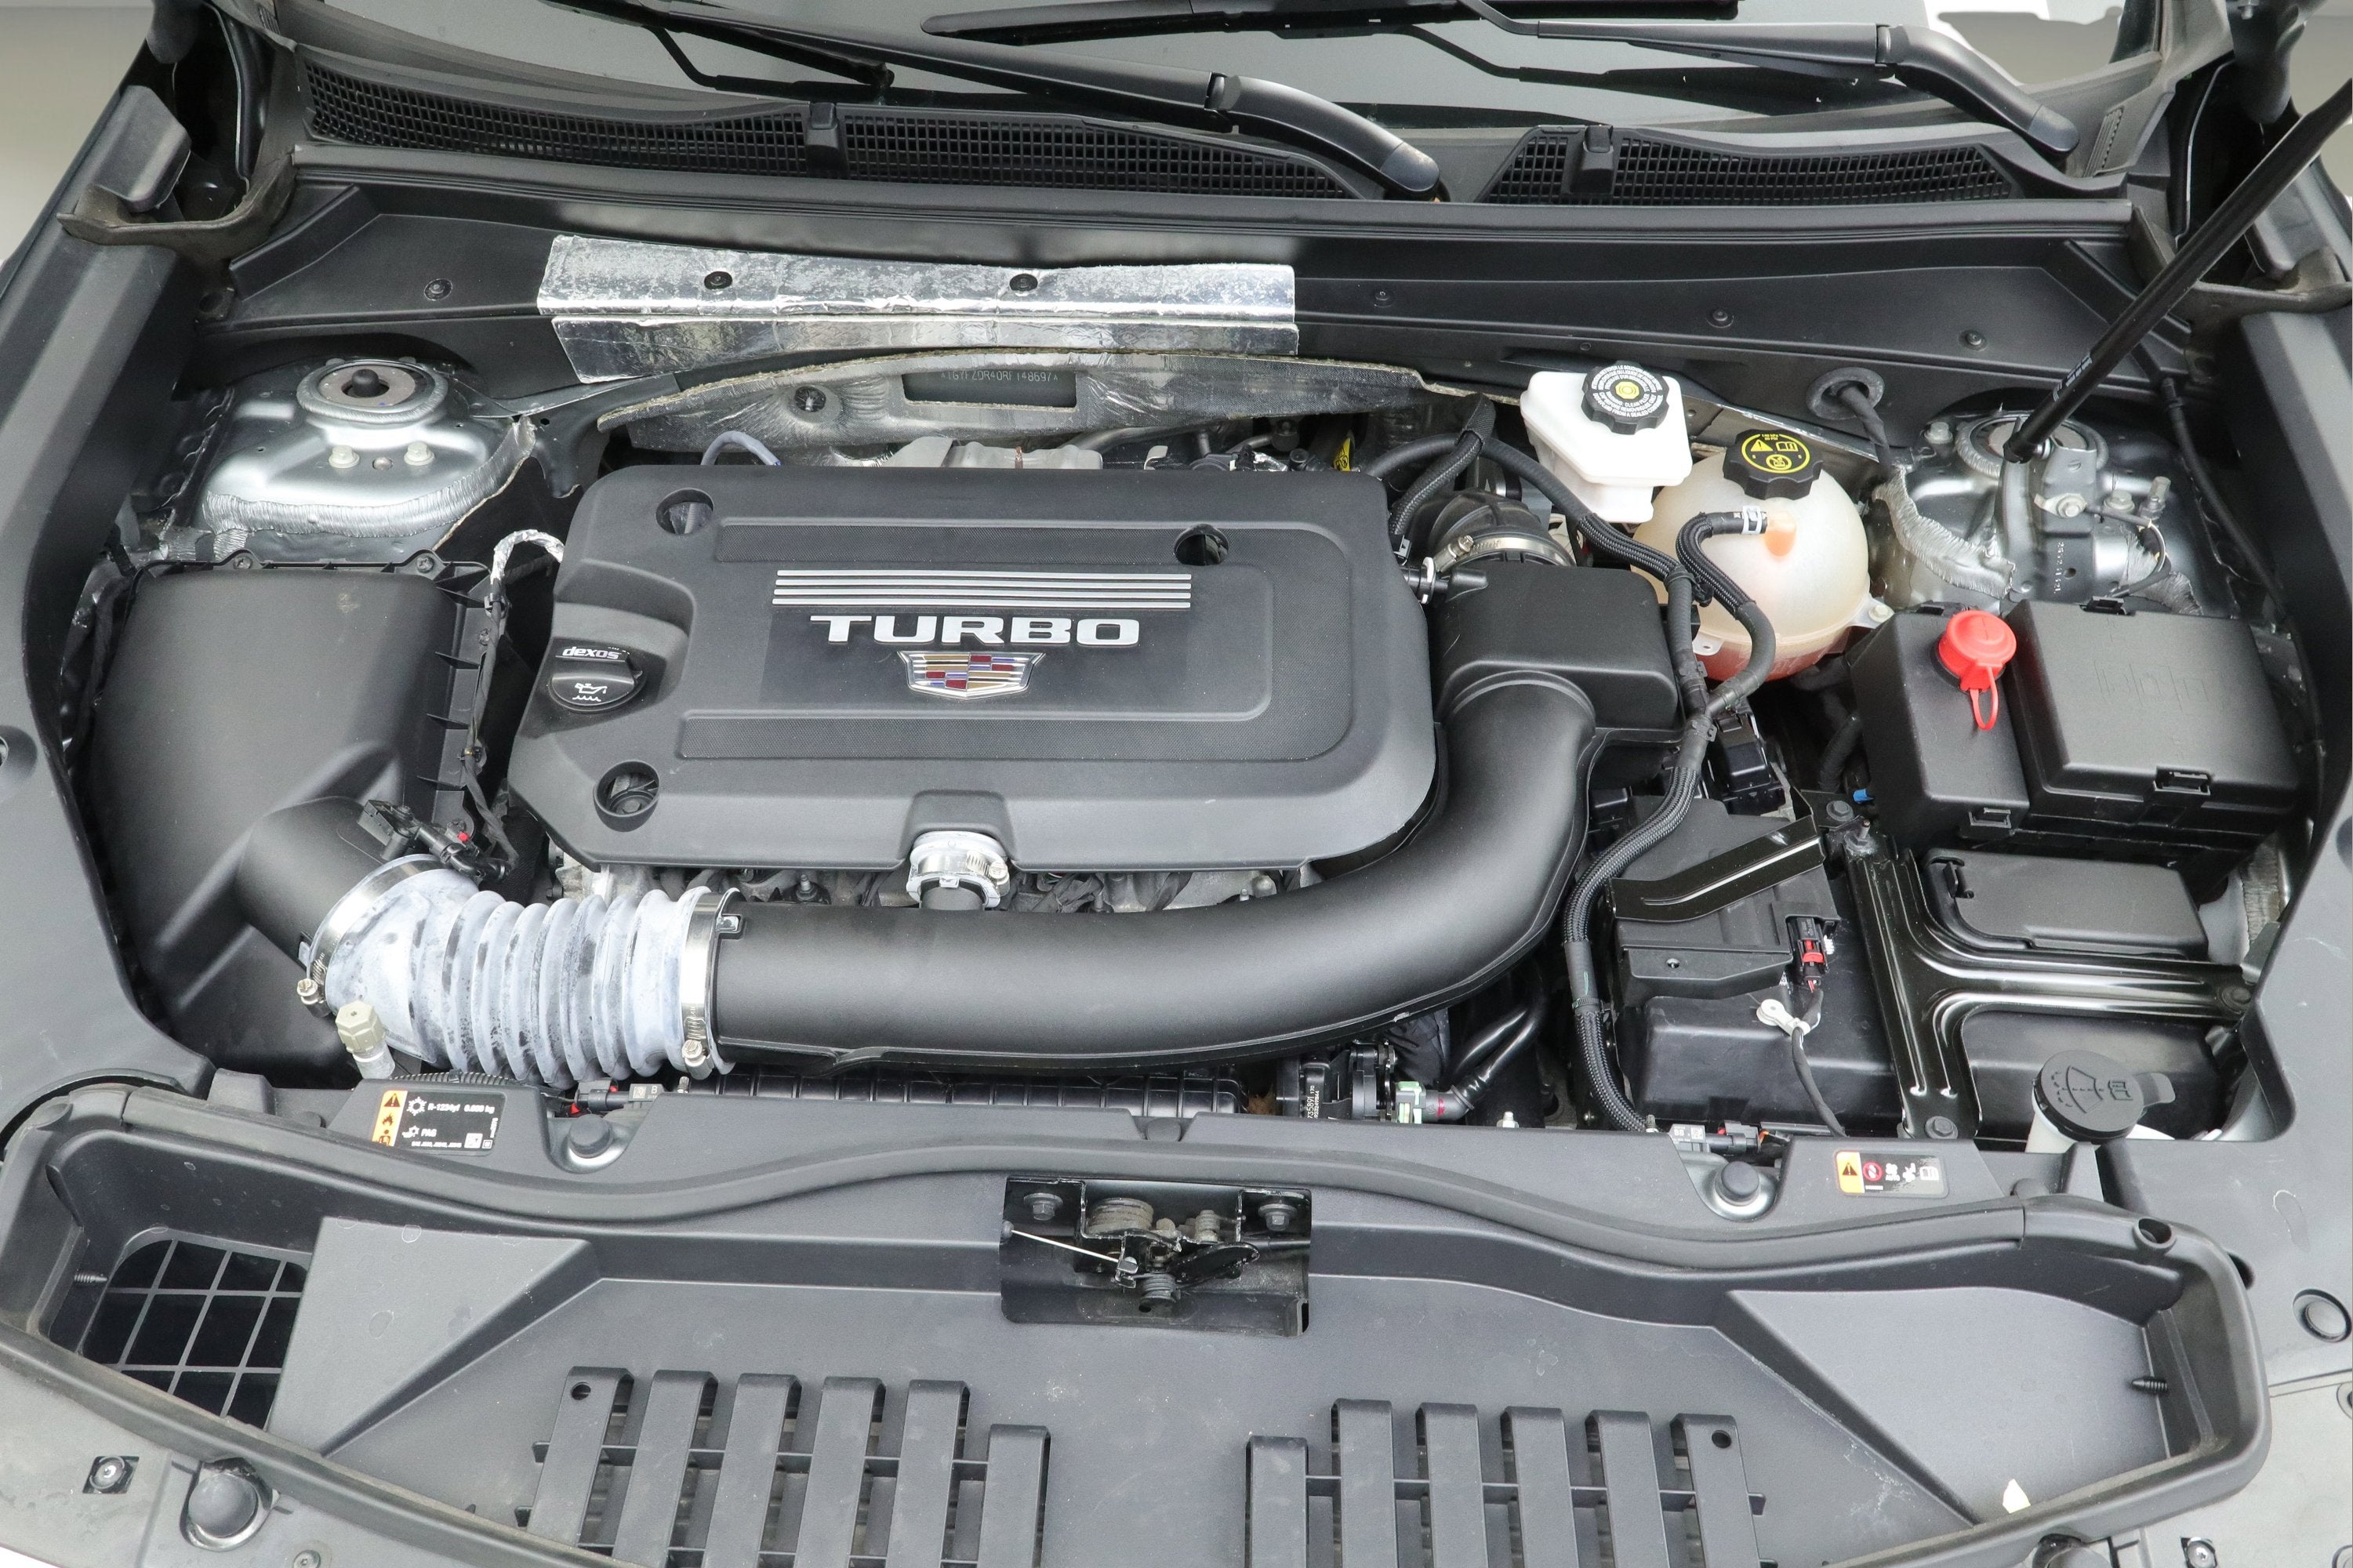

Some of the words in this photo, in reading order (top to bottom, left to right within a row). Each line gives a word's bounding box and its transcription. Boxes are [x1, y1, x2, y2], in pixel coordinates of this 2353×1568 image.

[810, 615, 1140, 646] TURBO
[562, 646, 622, 660] dexos
[651, 1085, 658, 1094] B
[420, 1129, 438, 1138] PAG
